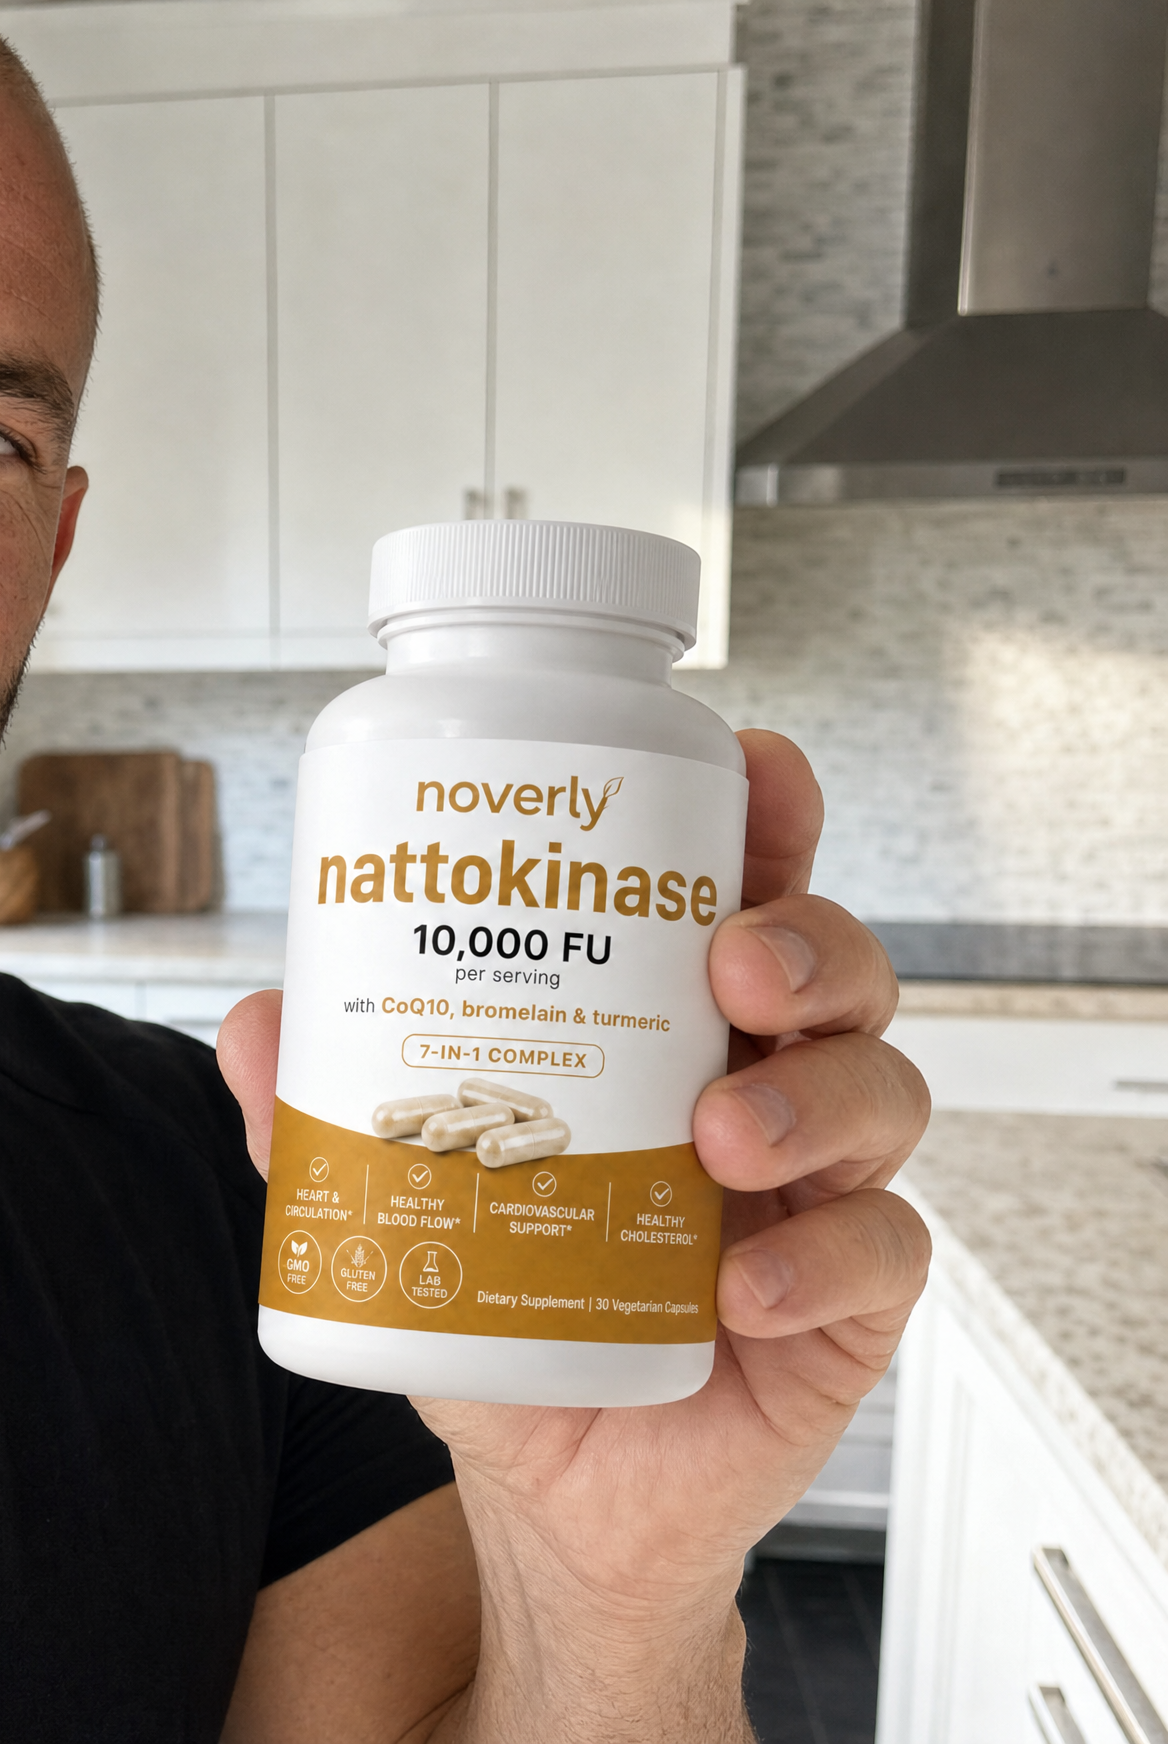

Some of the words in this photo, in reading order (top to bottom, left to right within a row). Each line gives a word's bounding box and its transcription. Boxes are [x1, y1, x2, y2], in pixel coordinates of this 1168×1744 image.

[416, 775, 623, 832] noverly
[317, 839, 718, 927] nattokinase
[413, 924, 549, 962] 10,000
[562, 931, 612, 965] FU
[455, 967, 486, 985] per
[492, 968, 561, 990] serving
[343, 997, 375, 1013] with
[381, 996, 455, 1020] CoQ10,
[462, 1000, 567, 1024] bromelain
[572, 1008, 586, 1025] &
[592, 1009, 671, 1033] turmeric
[419, 1044, 480, 1062] 7-IN-1
[487, 1046, 588, 1069] COMPLEX
[296, 1188, 330, 1203] HEART
[331, 1191, 340, 1204] &
[390, 1194, 445, 1211] HEALTHY
[377, 1211, 418, 1227] BLOOD
[489, 1201, 595, 1222] CARDIOVASCULAR
[636, 1212, 686, 1229] HEALTHY
[286, 1259, 310, 1273] GMO
[340, 1267, 376, 1281] GLUTEN
[286, 1273, 307, 1286] FREE
[346, 1281, 368, 1293] FREE
[418, 1274, 442, 1287] LAB
[411, 1286, 448, 1299] TESTED
[477, 1290, 519, 1310] Dietary
[520, 1293, 586, 1311] Supplement
[595, 1297, 610, 1311] 30
[611, 1298, 663, 1316] Vegetarian
[664, 1301, 699, 1316] Capsules
